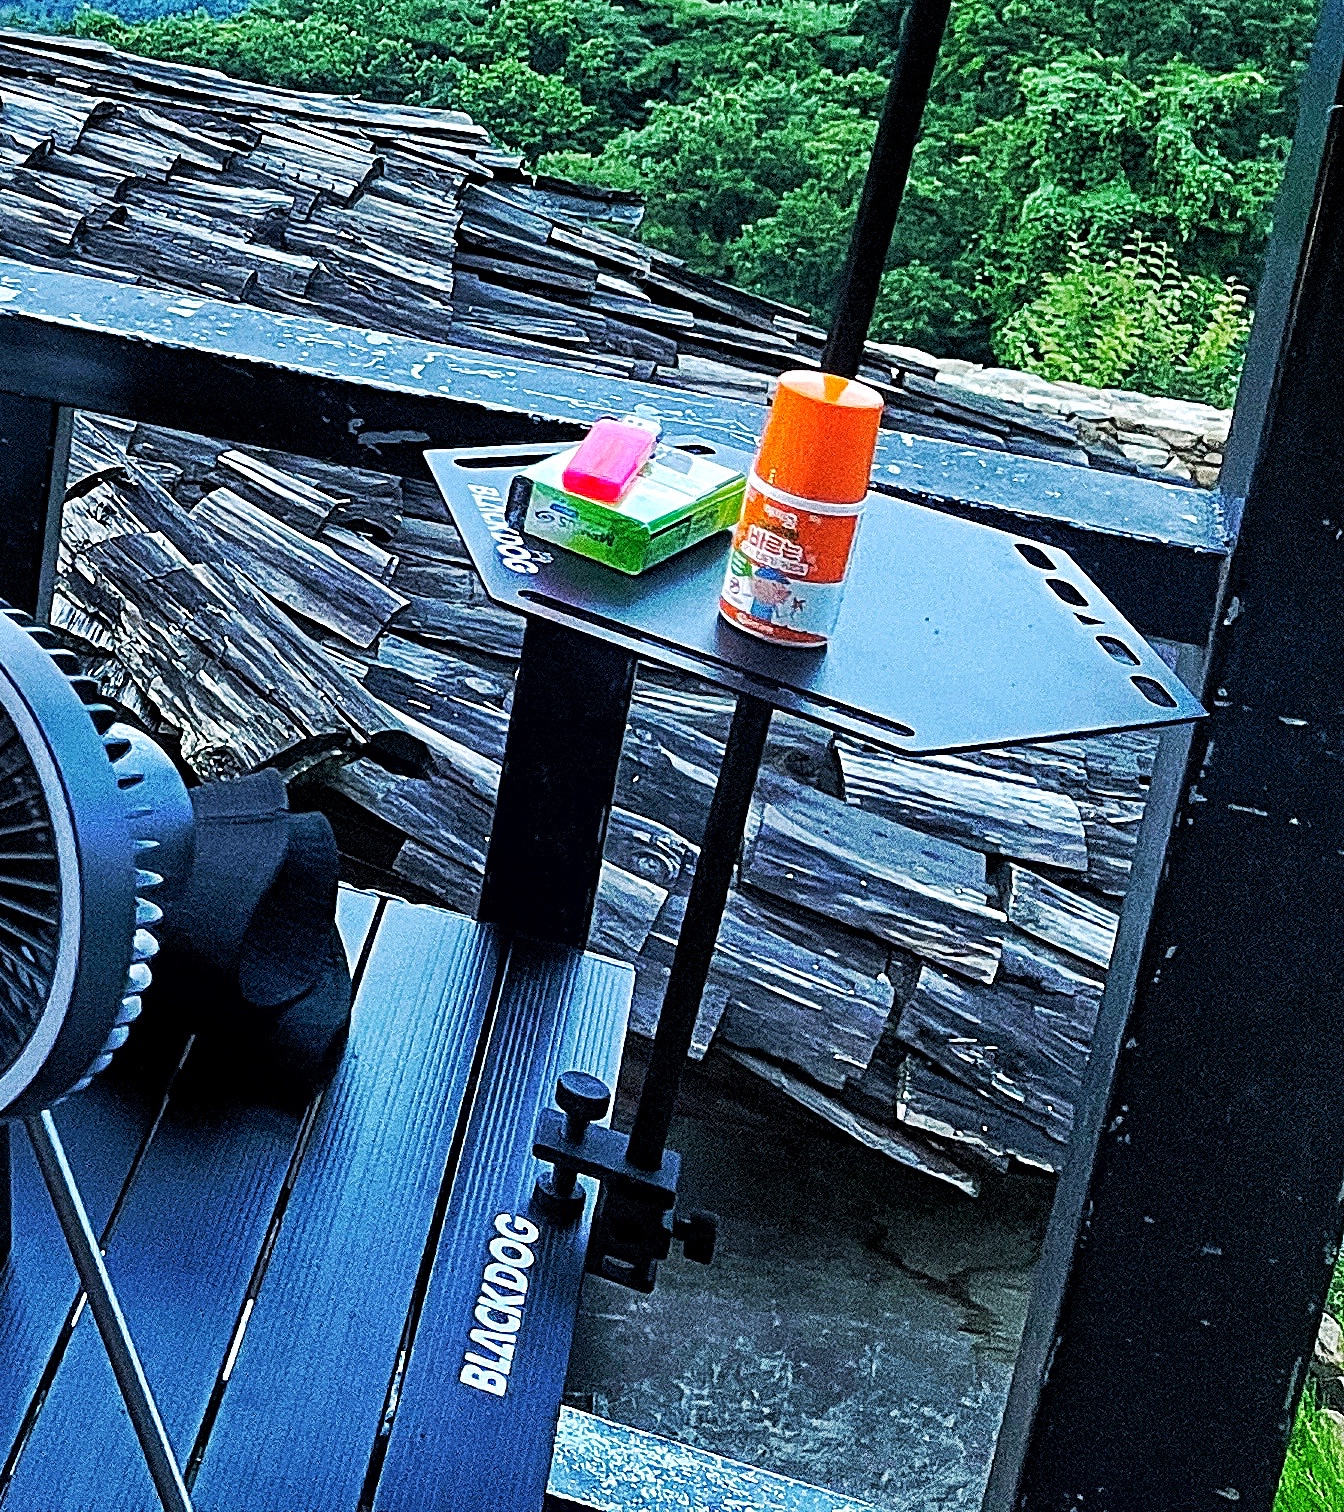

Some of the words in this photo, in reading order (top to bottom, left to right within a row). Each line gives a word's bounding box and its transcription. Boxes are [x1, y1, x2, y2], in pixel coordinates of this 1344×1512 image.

[467, 483, 539, 574] BLACKDOG
[750, 526, 804, 562] 바르는
[459, 1213, 541, 1398] BLACKDOG
